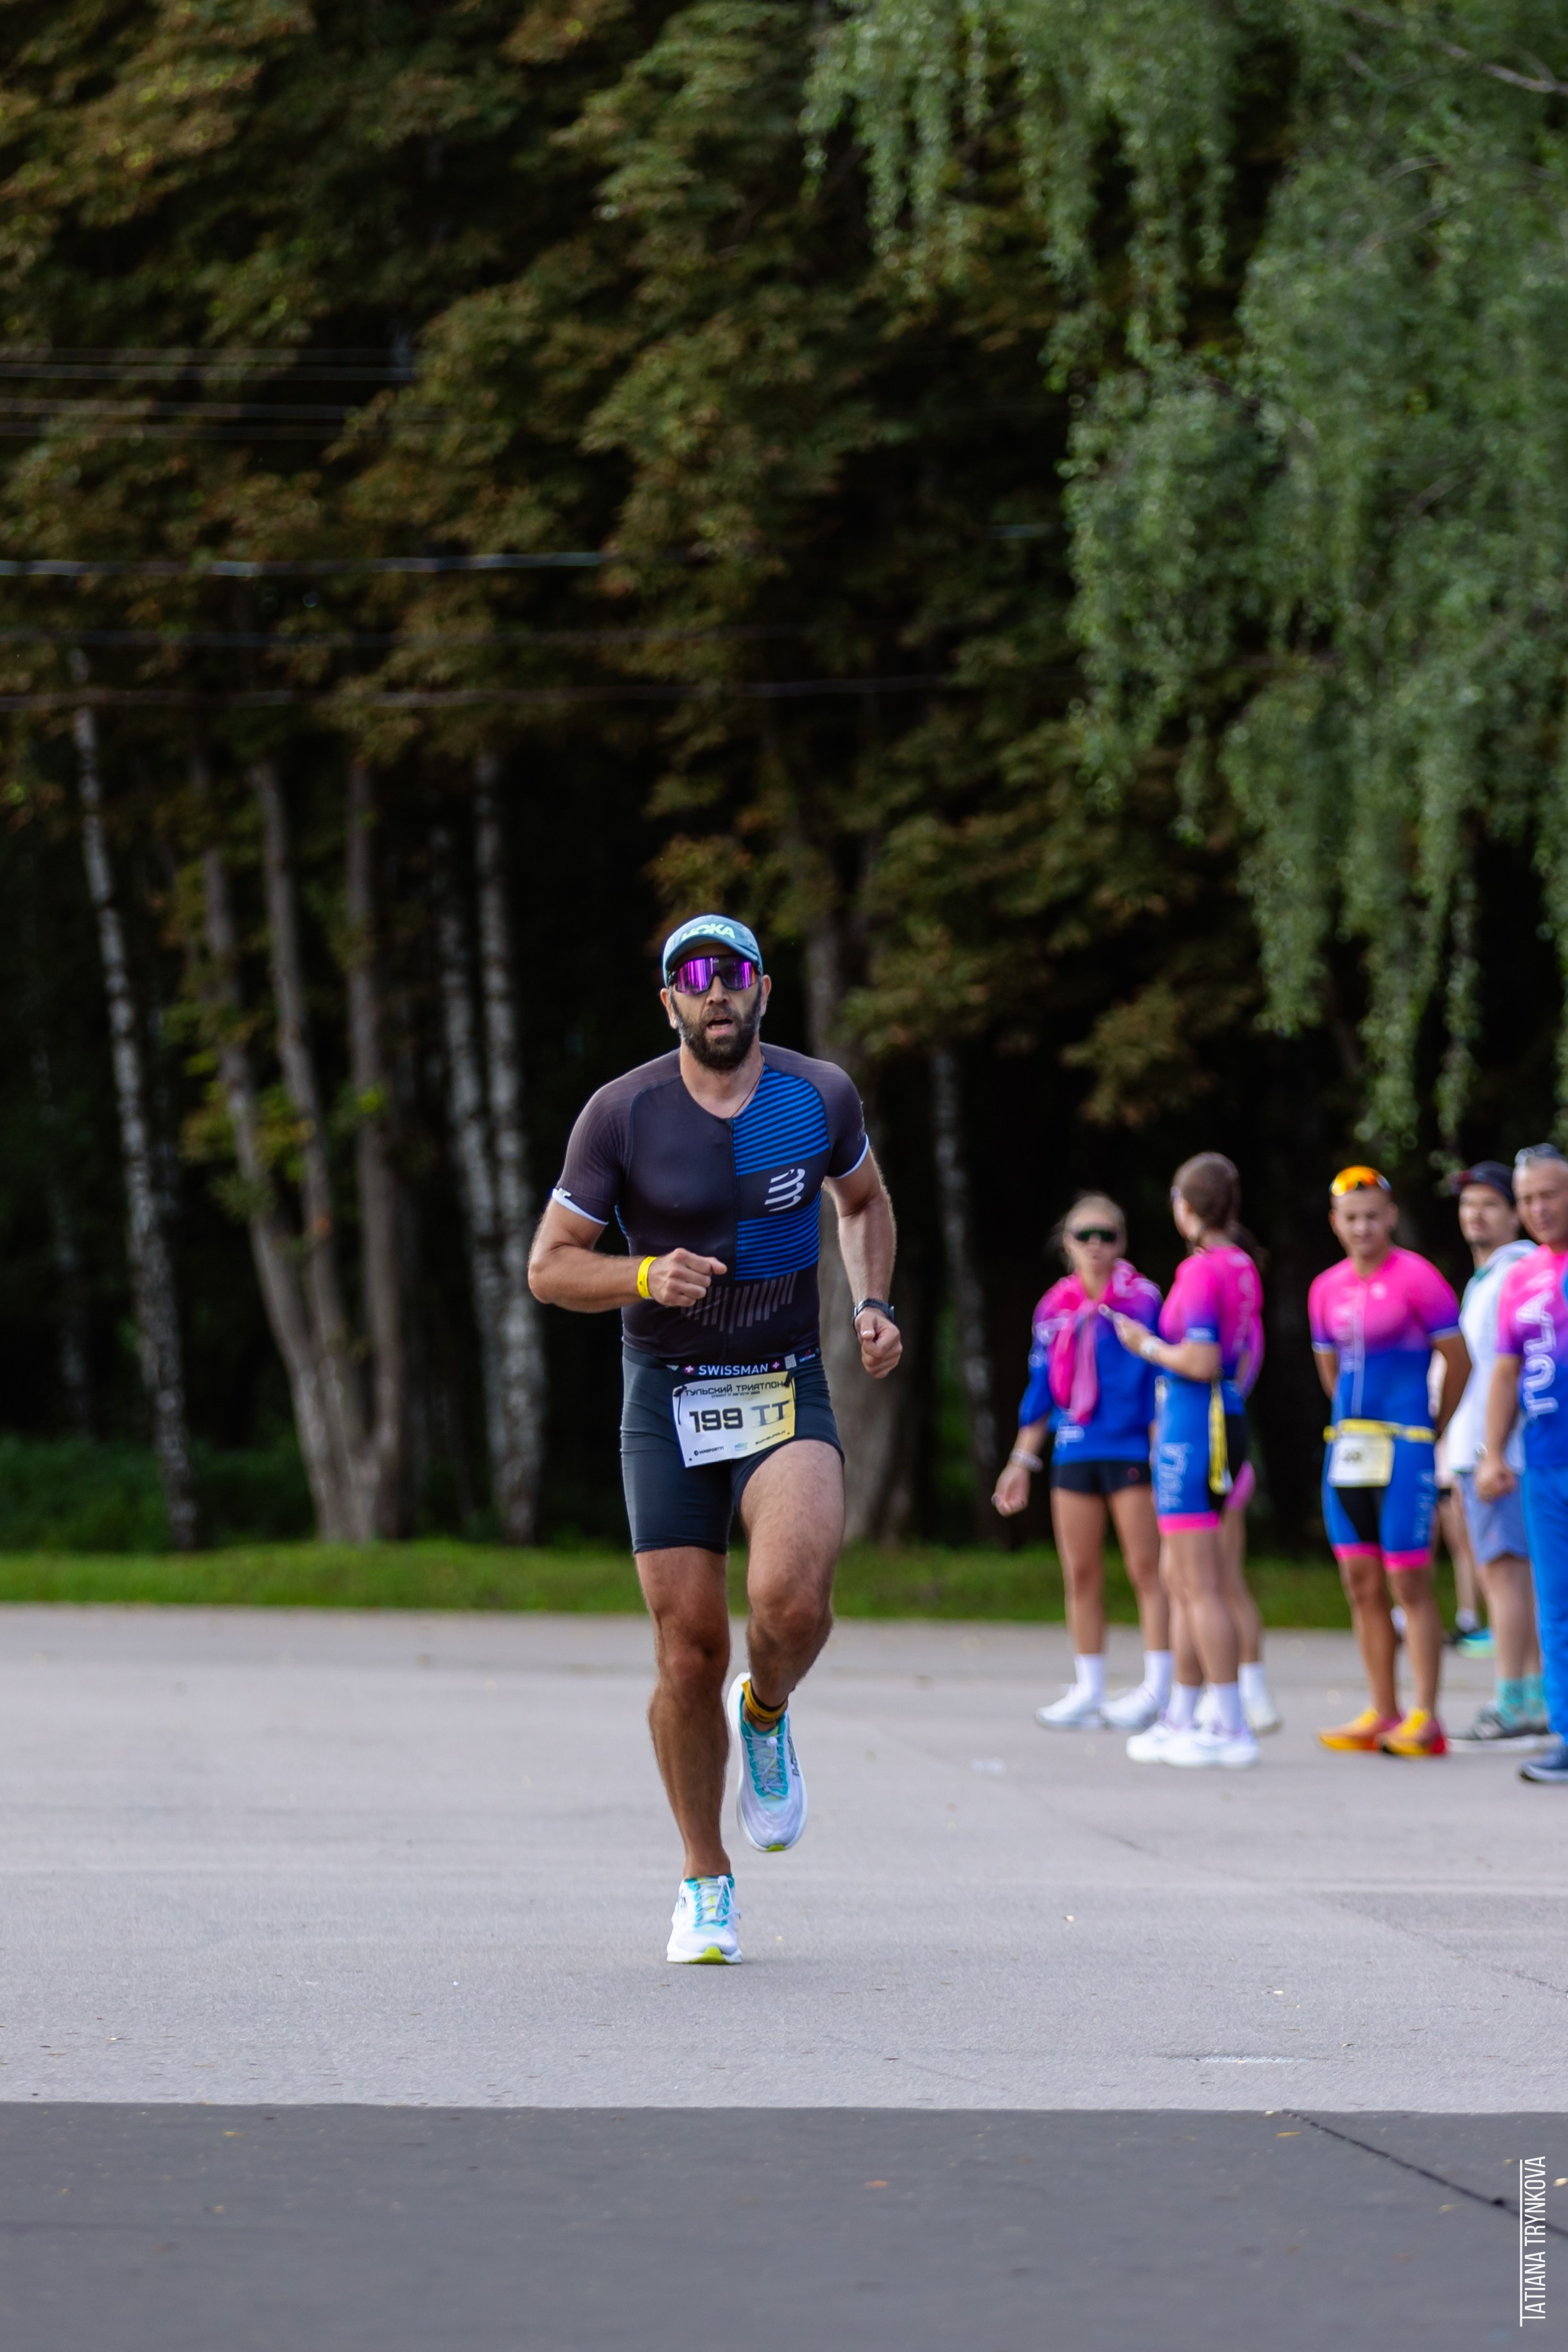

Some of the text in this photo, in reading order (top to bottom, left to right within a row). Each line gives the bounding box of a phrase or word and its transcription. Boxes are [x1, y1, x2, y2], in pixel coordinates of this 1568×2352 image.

[698, 1363, 769, 1376] SWISSMAN
[684, 1381, 783, 1397] ТУЛЬСКИЙ ТРИАТЛОН
[689, 1407, 744, 1433] 199
